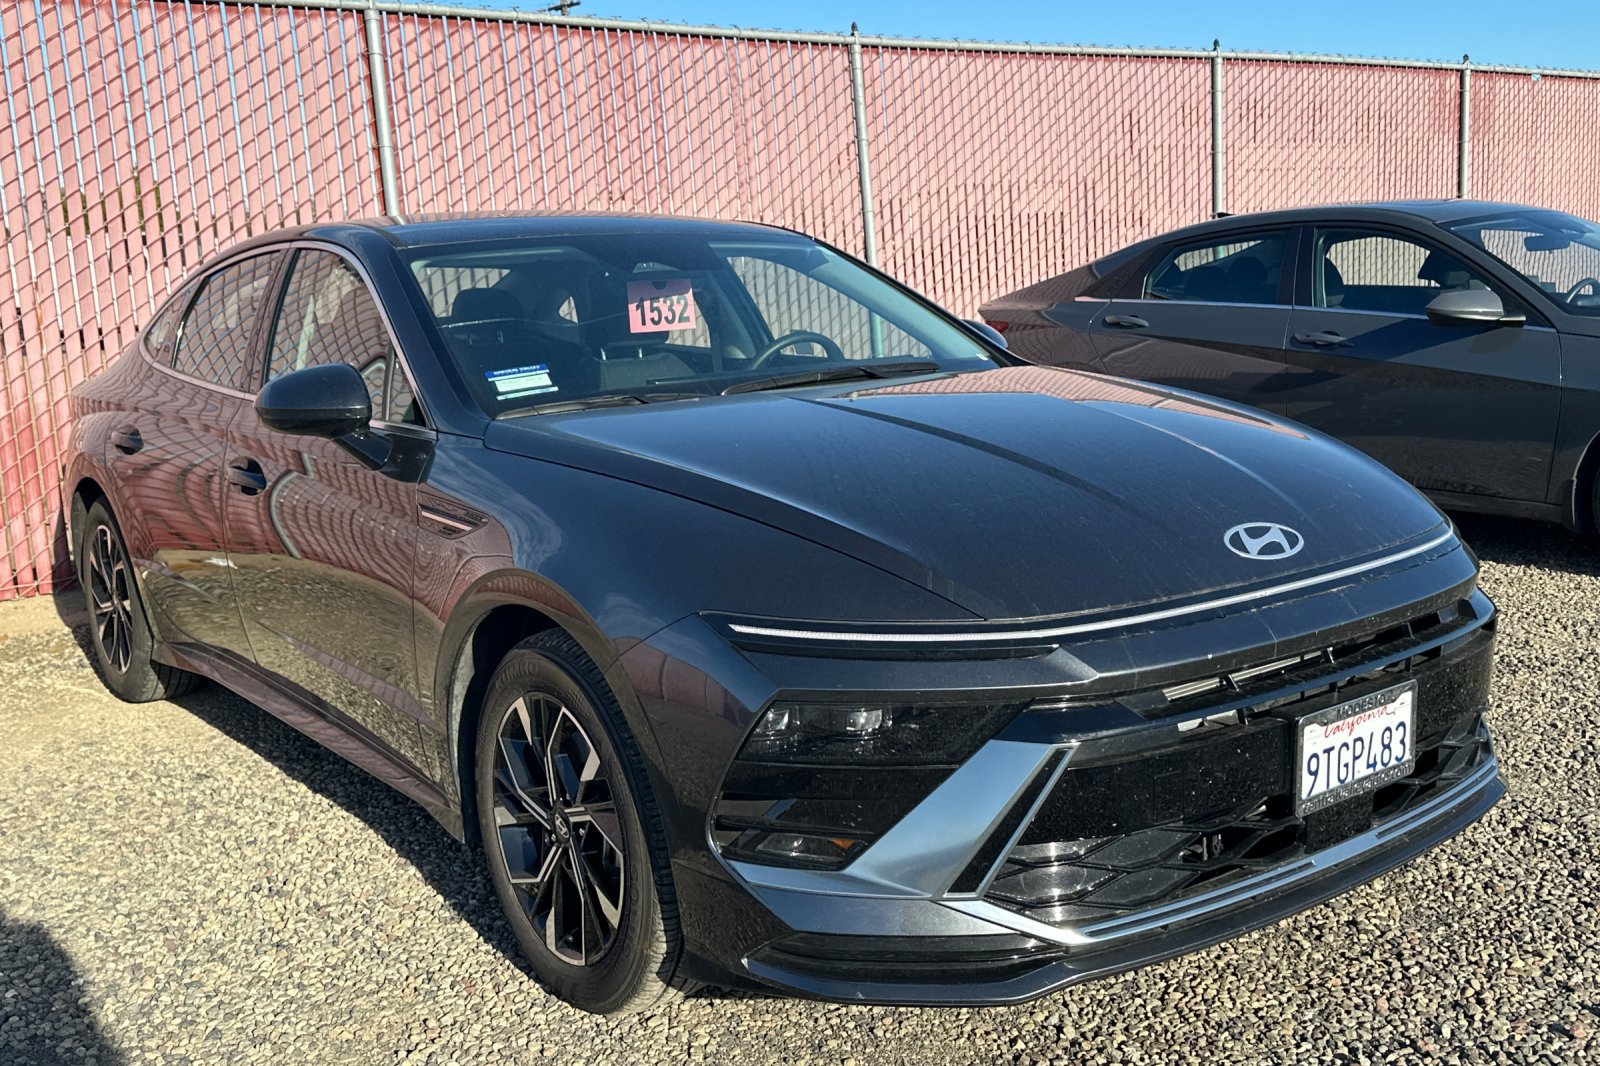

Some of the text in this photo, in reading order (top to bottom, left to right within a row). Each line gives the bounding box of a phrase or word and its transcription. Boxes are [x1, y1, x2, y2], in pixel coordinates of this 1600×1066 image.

[636, 295, 690, 326] 1532
[1324, 704, 1396, 738] California
[1336, 693, 1386, 720] MODESTO
[1307, 720, 1407, 798] 9TGP483
